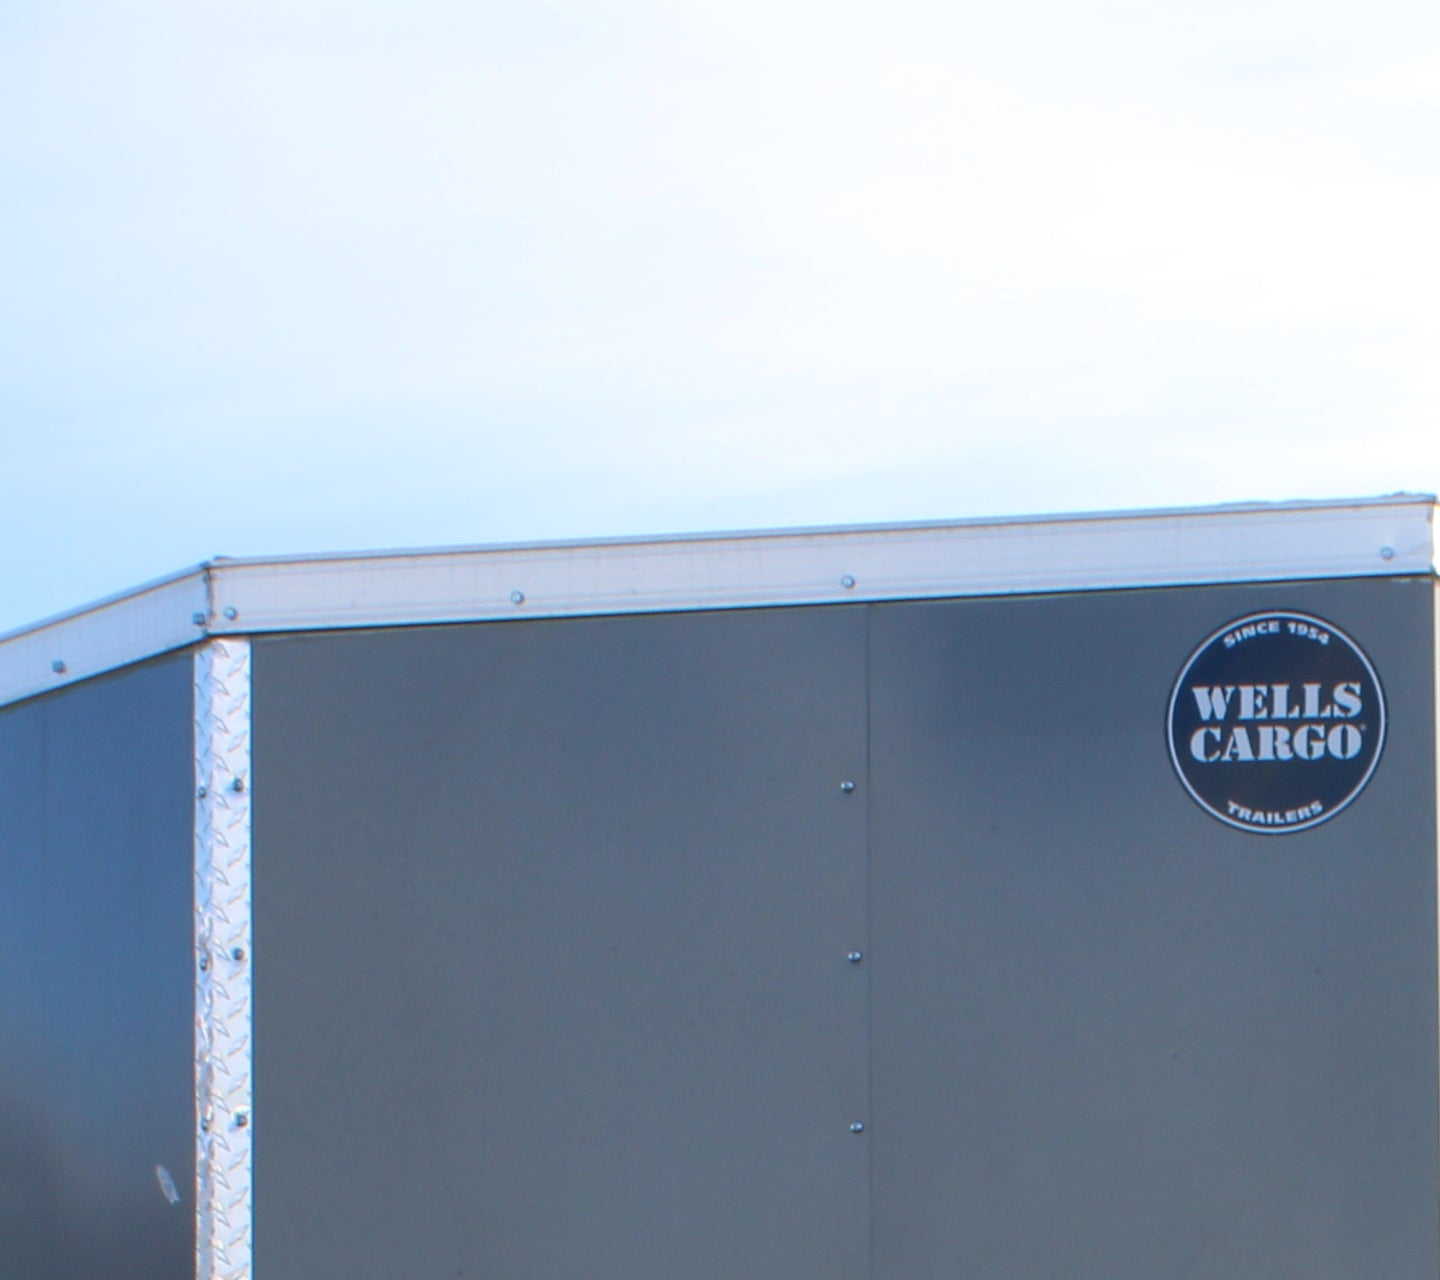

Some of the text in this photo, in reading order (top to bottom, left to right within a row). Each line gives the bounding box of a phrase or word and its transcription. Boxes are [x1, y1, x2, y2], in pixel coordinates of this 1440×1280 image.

[1222, 619, 1330, 649] SINCE 1954
[1190, 681, 1363, 722] WELLS
[1189, 723, 1363, 764] CARGO
[1226, 799, 1324, 825] TRAILERS
